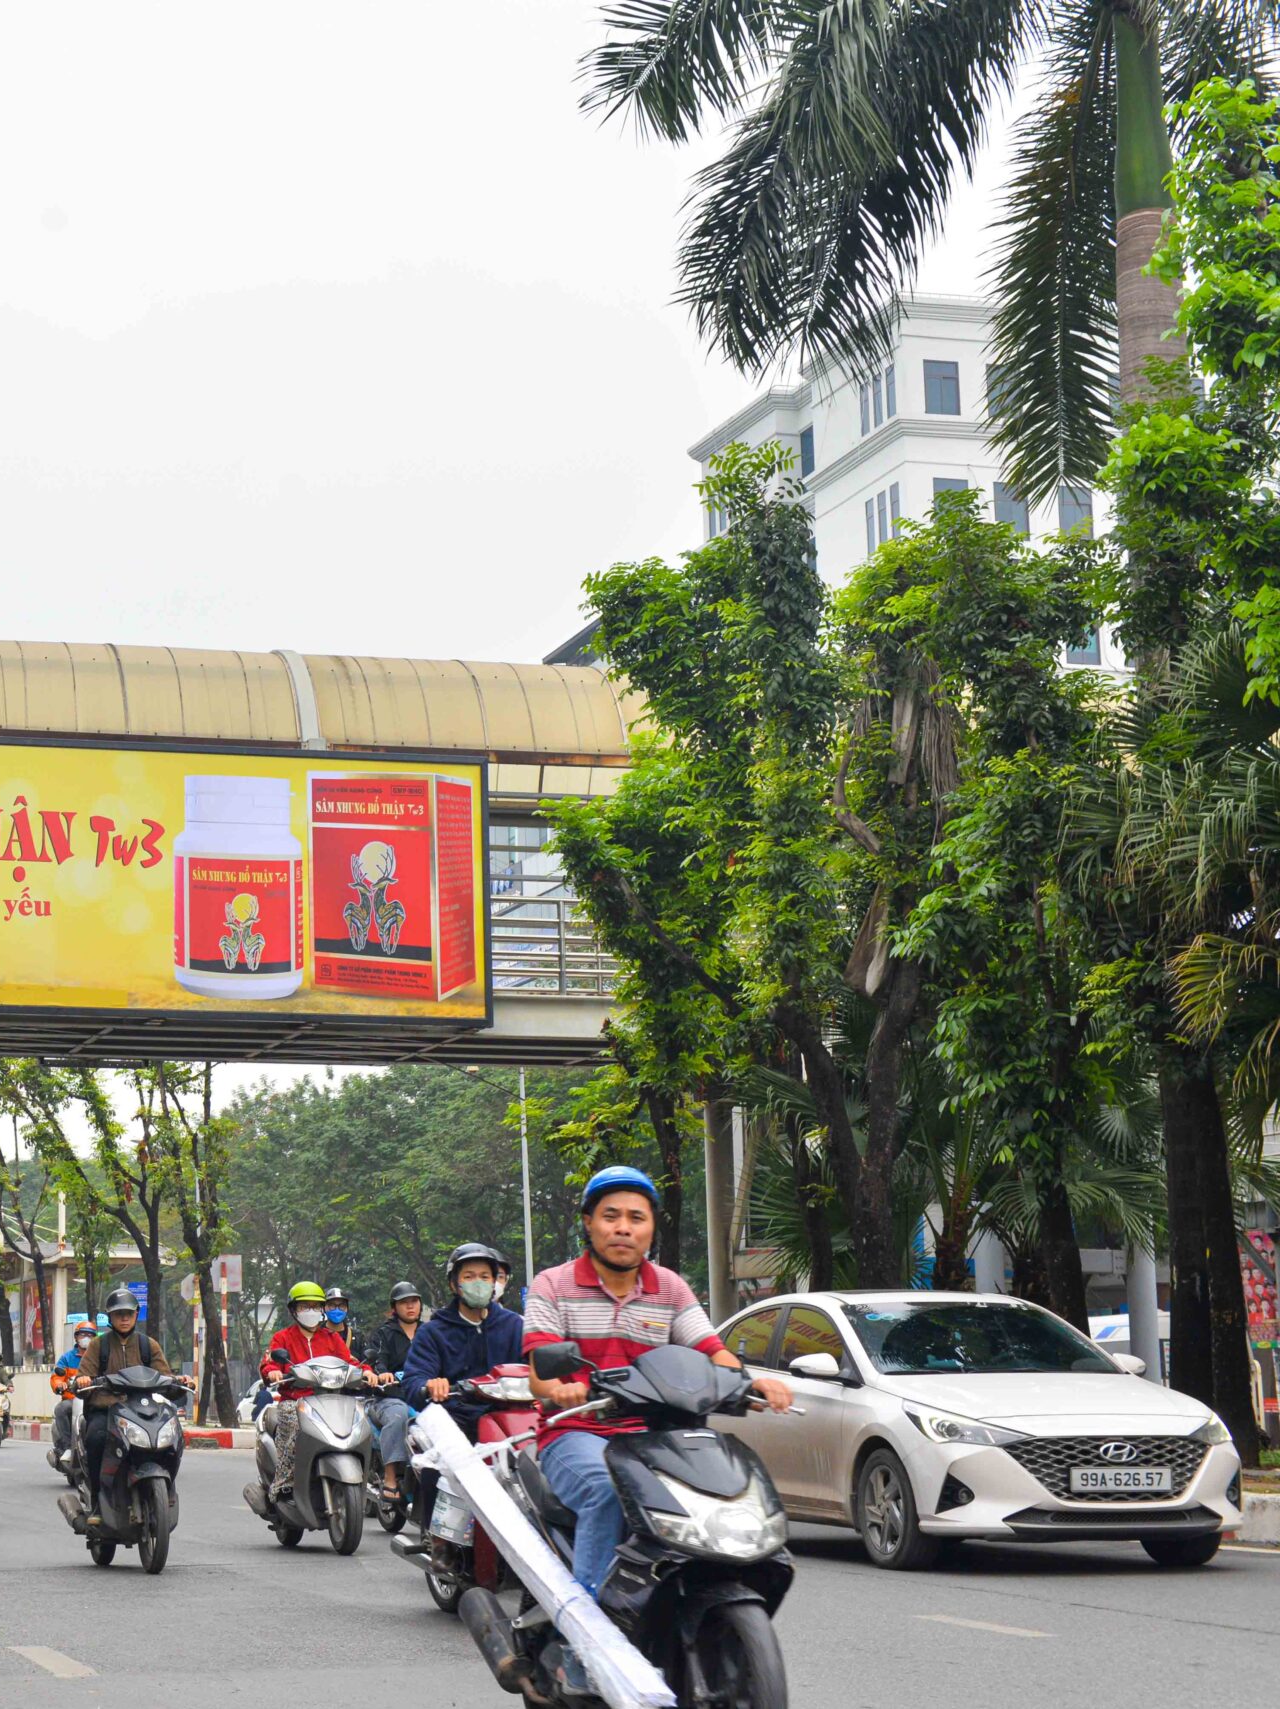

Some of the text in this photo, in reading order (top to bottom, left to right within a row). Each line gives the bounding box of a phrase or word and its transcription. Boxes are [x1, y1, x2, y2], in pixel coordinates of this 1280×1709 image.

[315, 796, 334, 813] SÂM
[336, 801, 366, 814] NHUNG
[367, 795, 380, 814] BỔ
[381, 800, 404, 820] THẬN
[192, 866, 207, 881] SÂM
[208, 870, 236, 883] NHUNG
[238, 865, 250, 883] BỔ
[251, 868, 273, 888] THẬN
[3, 886, 52, 922] yếu
[1080, 1472, 1163, 1487] 99A-626.57
